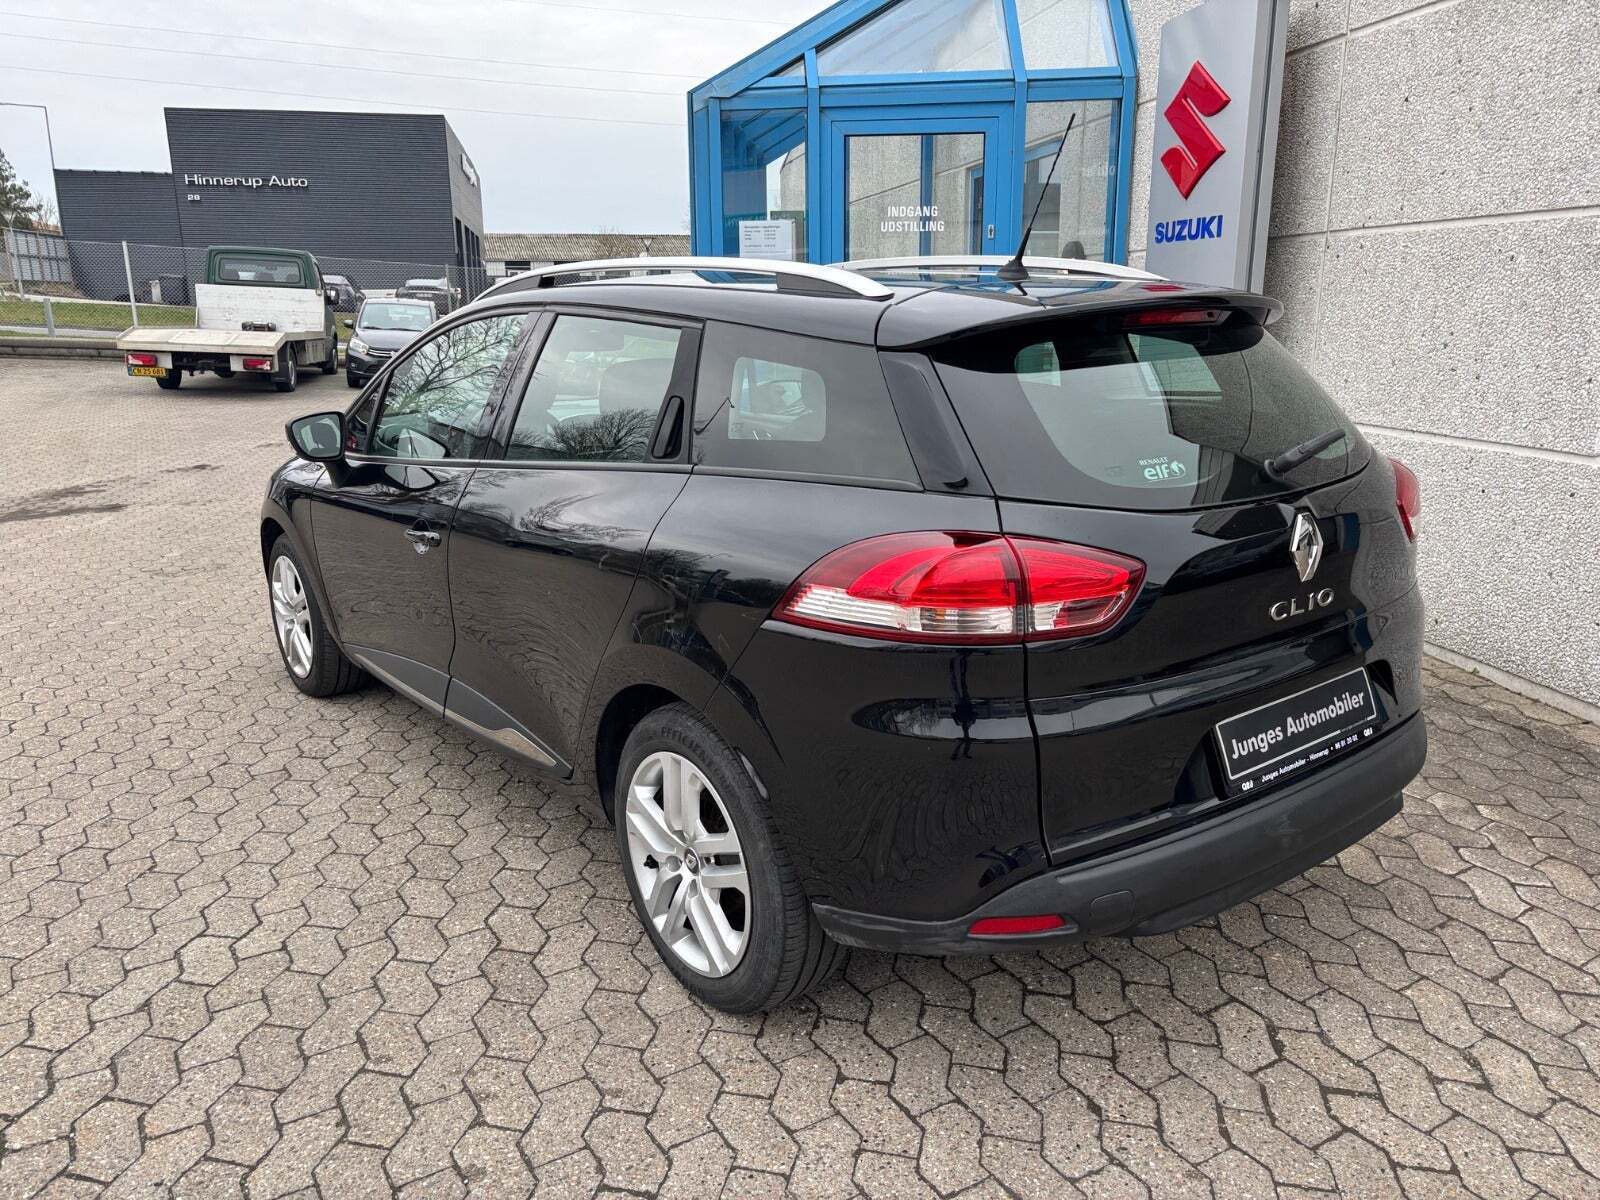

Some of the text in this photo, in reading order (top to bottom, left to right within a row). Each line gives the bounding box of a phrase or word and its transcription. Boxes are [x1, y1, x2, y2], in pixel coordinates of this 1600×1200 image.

[184, 174, 308, 188] Hinnerup Auto
[887, 205, 939, 217] INDGANG
[880, 220, 945, 232] UDSTILLING
[1154, 214, 1224, 244] SUZUKI
[1144, 463, 1170, 480] elf
[1270, 588, 1335, 621] CLIO
[1231, 691, 1365, 760] Junges Automobiler
[1261, 770, 1279, 783] Junges
